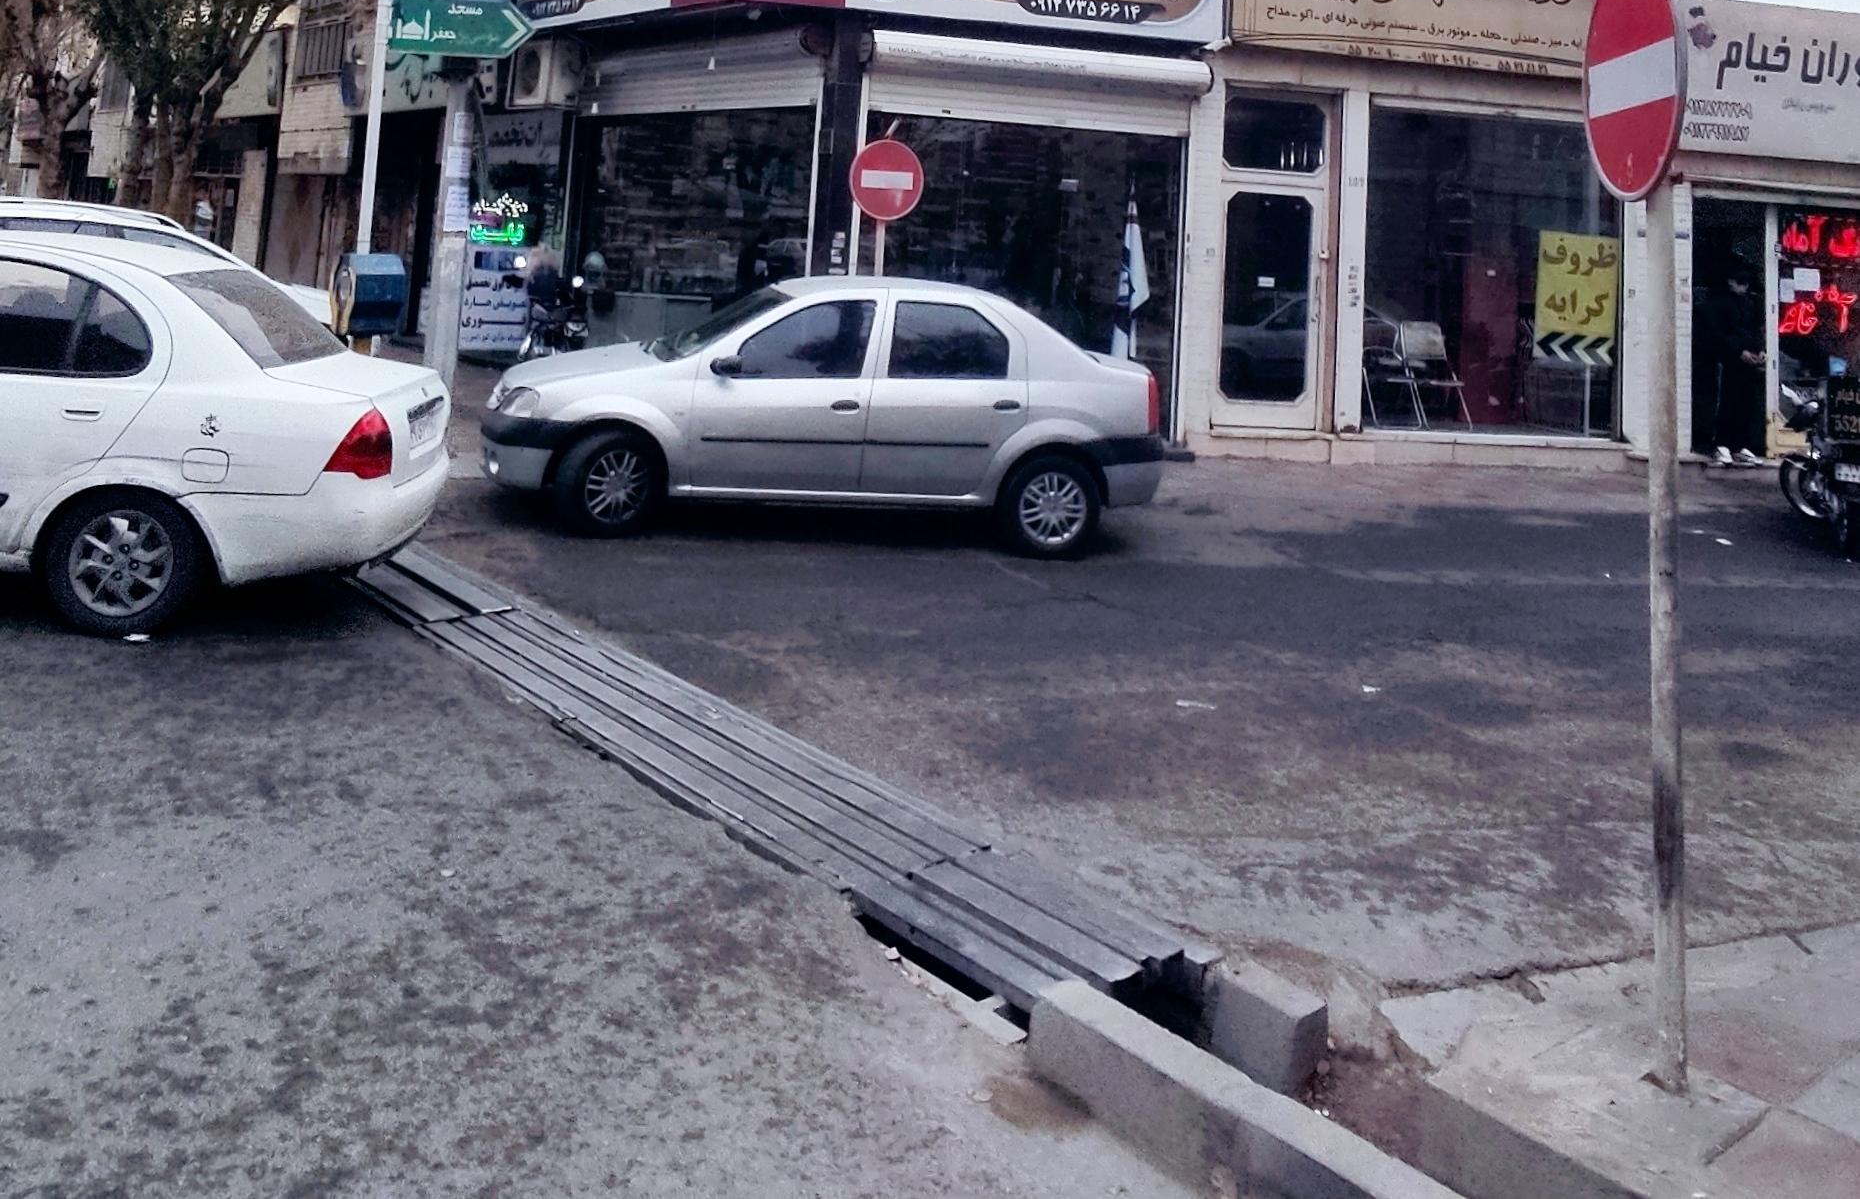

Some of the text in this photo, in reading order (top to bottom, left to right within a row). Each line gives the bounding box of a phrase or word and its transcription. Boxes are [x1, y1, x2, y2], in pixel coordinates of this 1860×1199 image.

[448, 3, 483, 16] مسجد
[1100, 1, 1120, 18] ۶۶
[1124, 4, 1141, 20] ۱۴
[1428, 23, 1445, 35] برق
[1447, 26, 1470, 40] موتور
[1511, 33, 1540, 45] صندلی
[1548, 38, 1562, 48] میز
[1716, 33, 1792, 90] خیام
[1542, 238, 1616, 276] ظروف
[1544, 289, 1609, 325] کرایه
